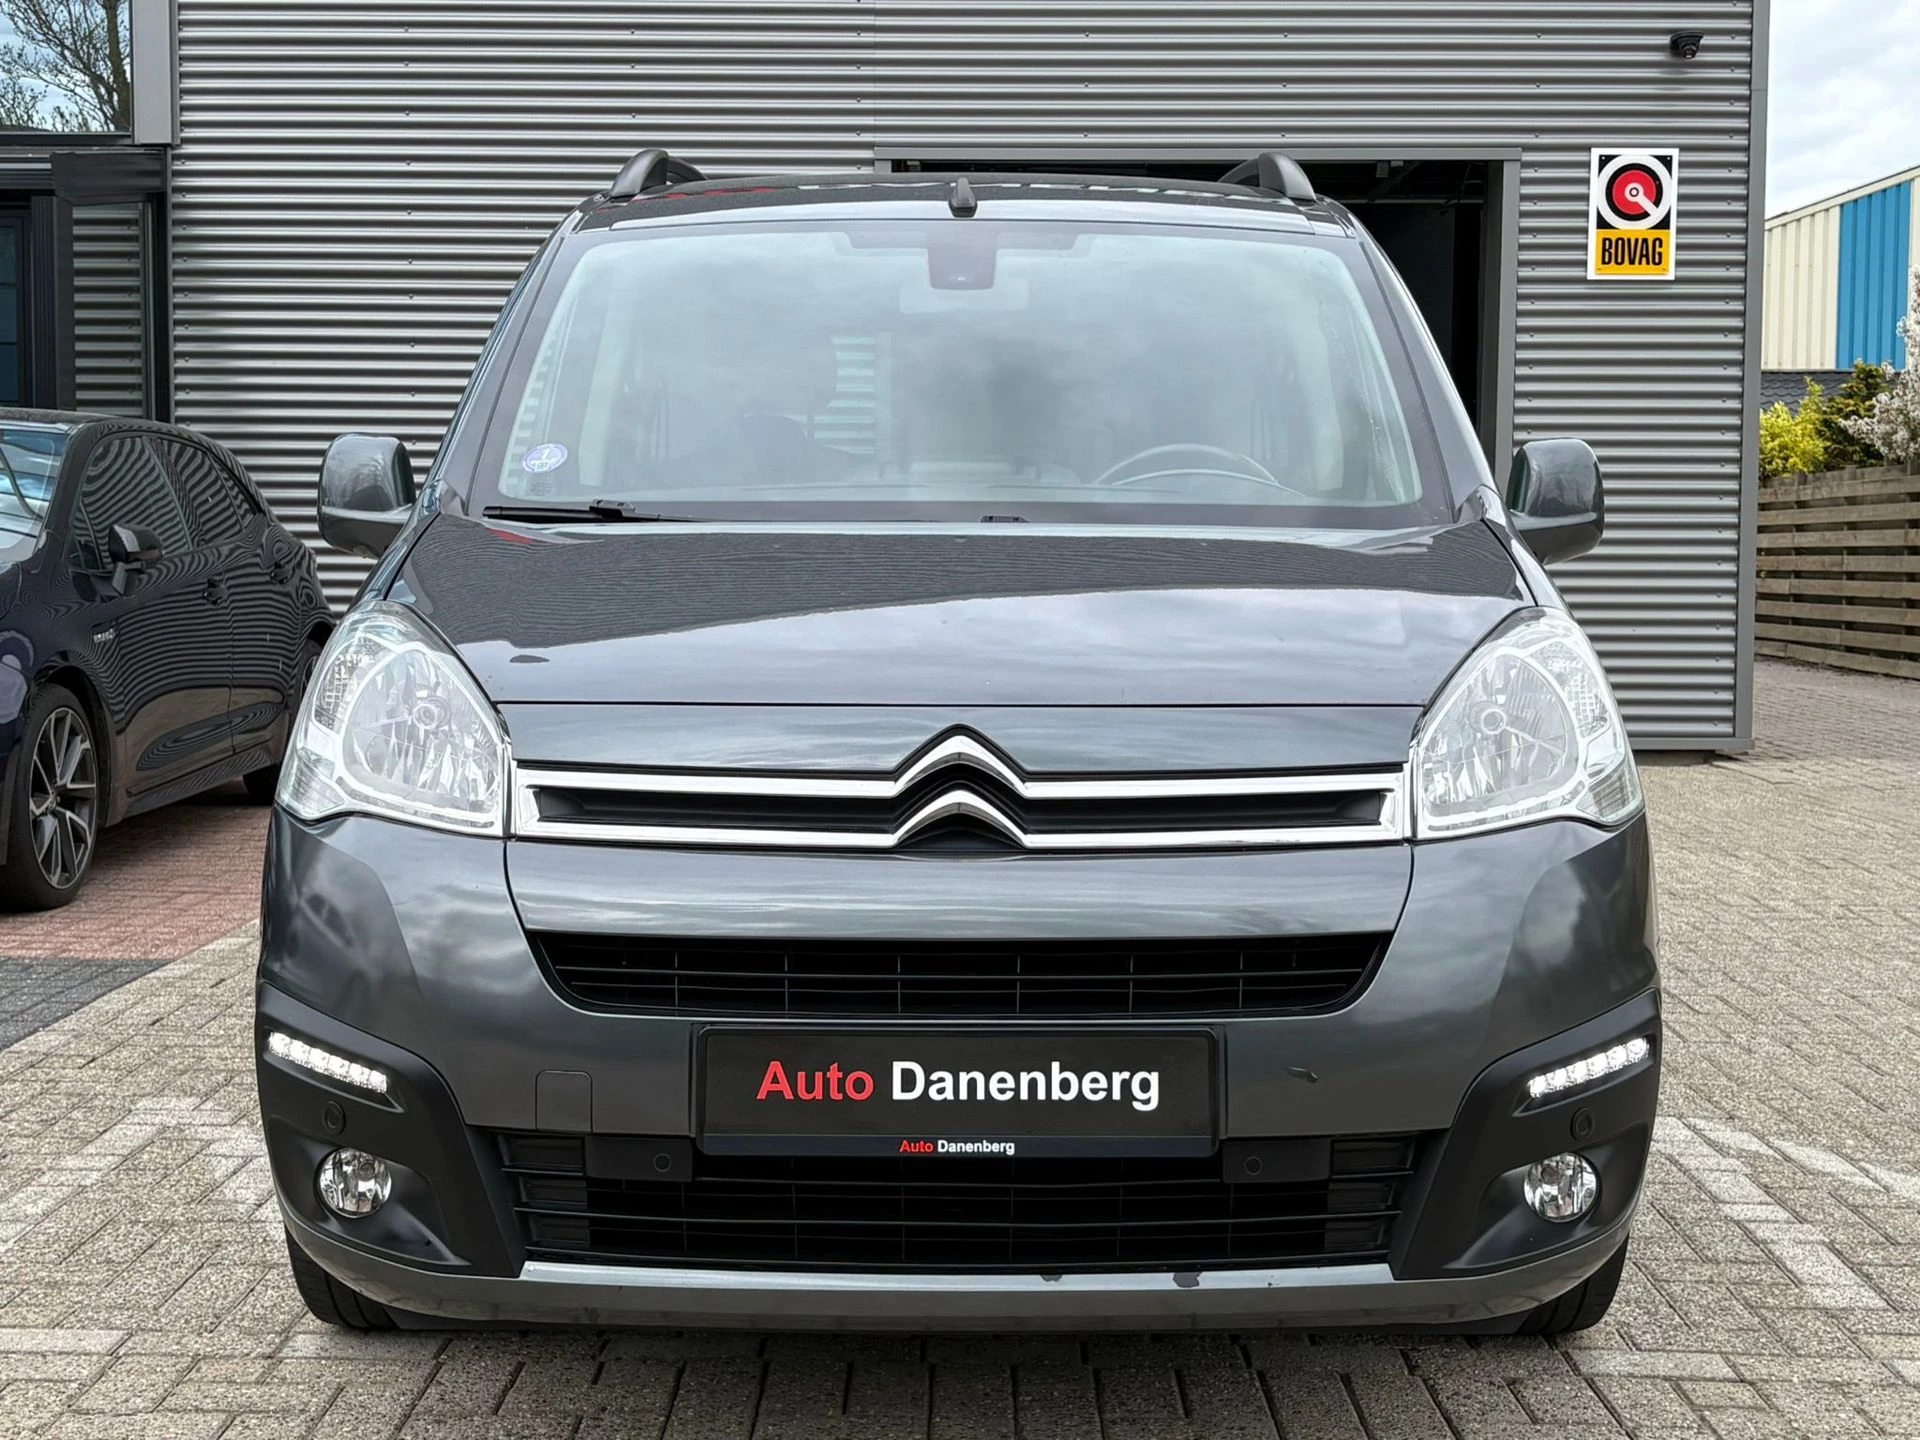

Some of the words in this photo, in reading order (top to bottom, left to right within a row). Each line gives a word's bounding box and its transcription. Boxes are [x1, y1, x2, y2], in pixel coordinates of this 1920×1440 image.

[1601, 237, 1663, 266] BOVAG
[757, 1061, 874, 1101] Auto
[892, 1061, 1160, 1112] Danenberg
[899, 1140, 933, 1153] Auto
[937, 1140, 1015, 1155] Danenberg
